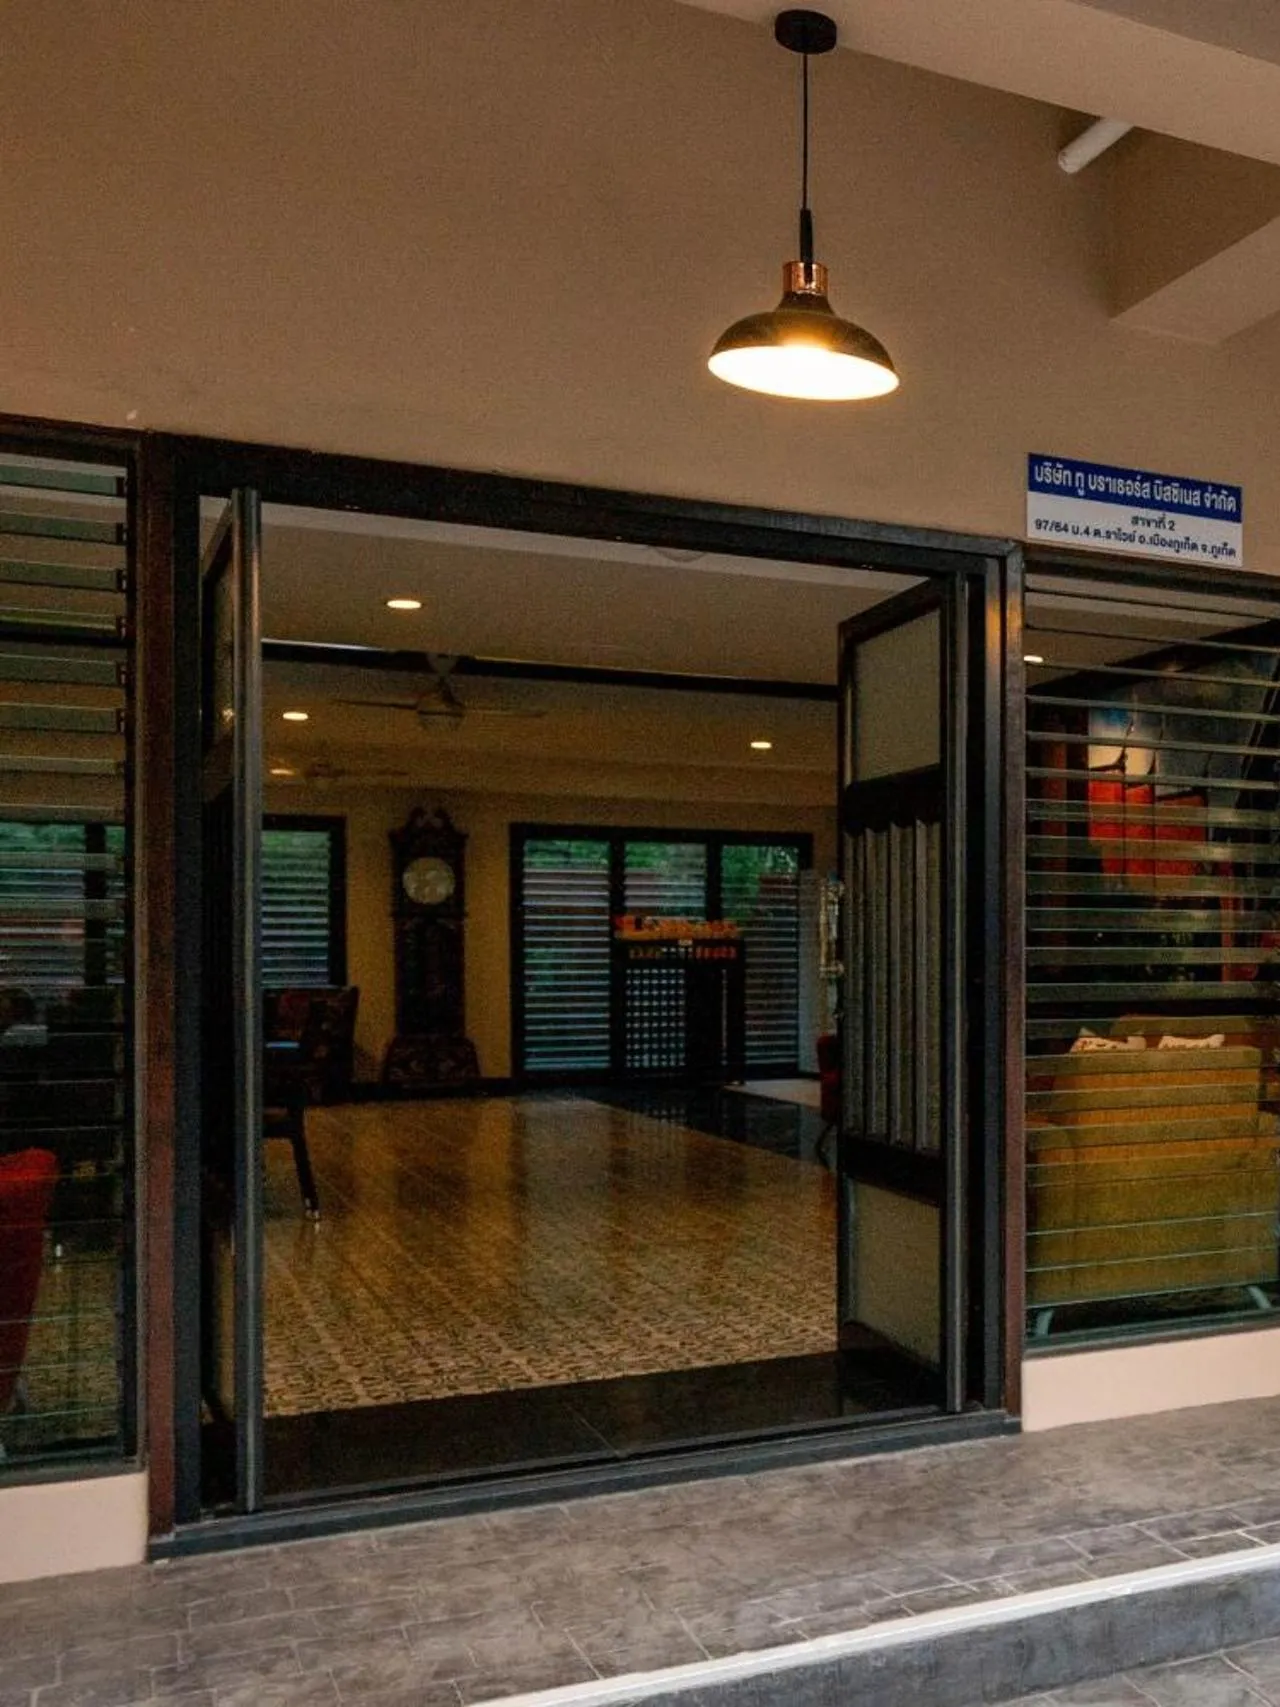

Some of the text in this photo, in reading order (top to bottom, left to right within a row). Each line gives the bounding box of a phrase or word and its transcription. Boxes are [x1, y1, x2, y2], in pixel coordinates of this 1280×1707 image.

[1034, 461, 1072, 487] บริษัท
[1075, 471, 1086, 496] ทู
[1087, 474, 1151, 499] บราเธอร์ส
[1203, 486, 1237, 513] จำกัด
[1131, 513, 1176, 531] สาขาที่ 2
